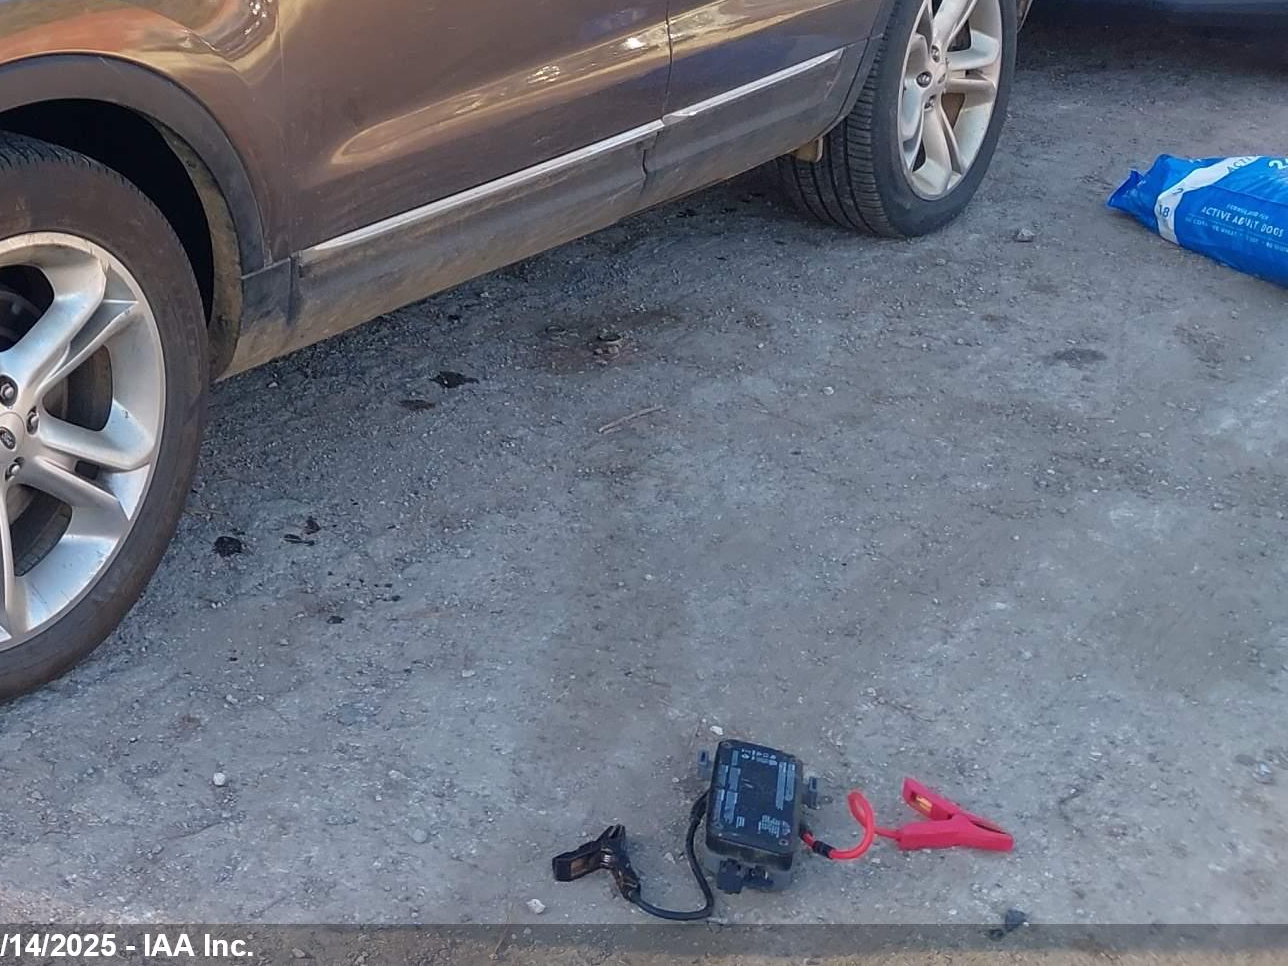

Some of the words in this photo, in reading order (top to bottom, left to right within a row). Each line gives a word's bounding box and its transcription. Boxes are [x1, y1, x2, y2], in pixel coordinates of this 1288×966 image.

[1268, 158, 1288, 170] 2
[1200, 206, 1233, 222] ACTIVE
[1260, 223, 1285, 238] DOGS
